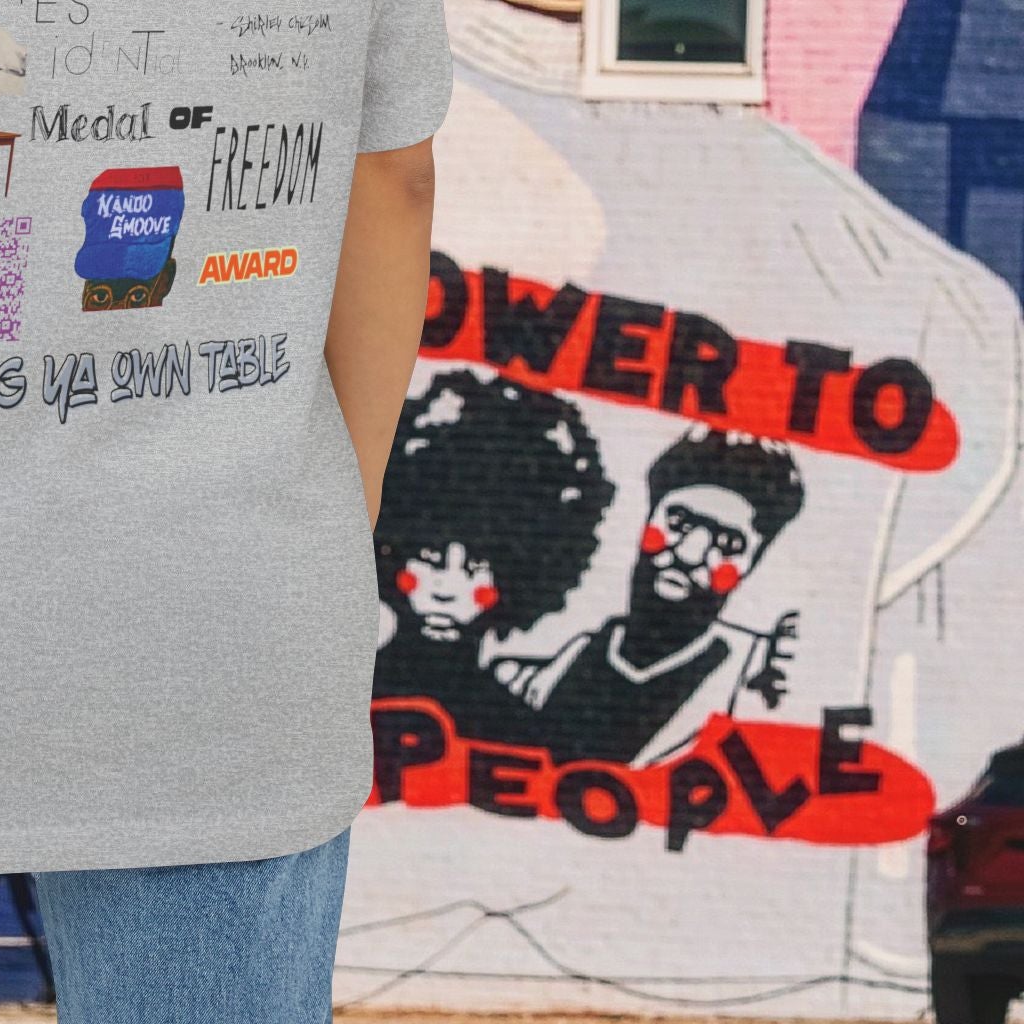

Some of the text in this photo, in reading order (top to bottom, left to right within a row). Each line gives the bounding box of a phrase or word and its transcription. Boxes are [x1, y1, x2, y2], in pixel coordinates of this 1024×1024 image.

[29, 102, 213, 143] Medal OF
[206, 121, 324, 212] FREEDOM
[96, 193, 153, 218] NANDO
[108, 214, 172, 240] SMOOVE
[197, 247, 299, 285] AWARD
[43, 353, 98, 425] YA
[111, 340, 192, 402] OWN
[199, 332, 291, 393] TABLE
[419, 250, 933, 454] OWER TO
[372, 706, 881, 852] PEOPLE
